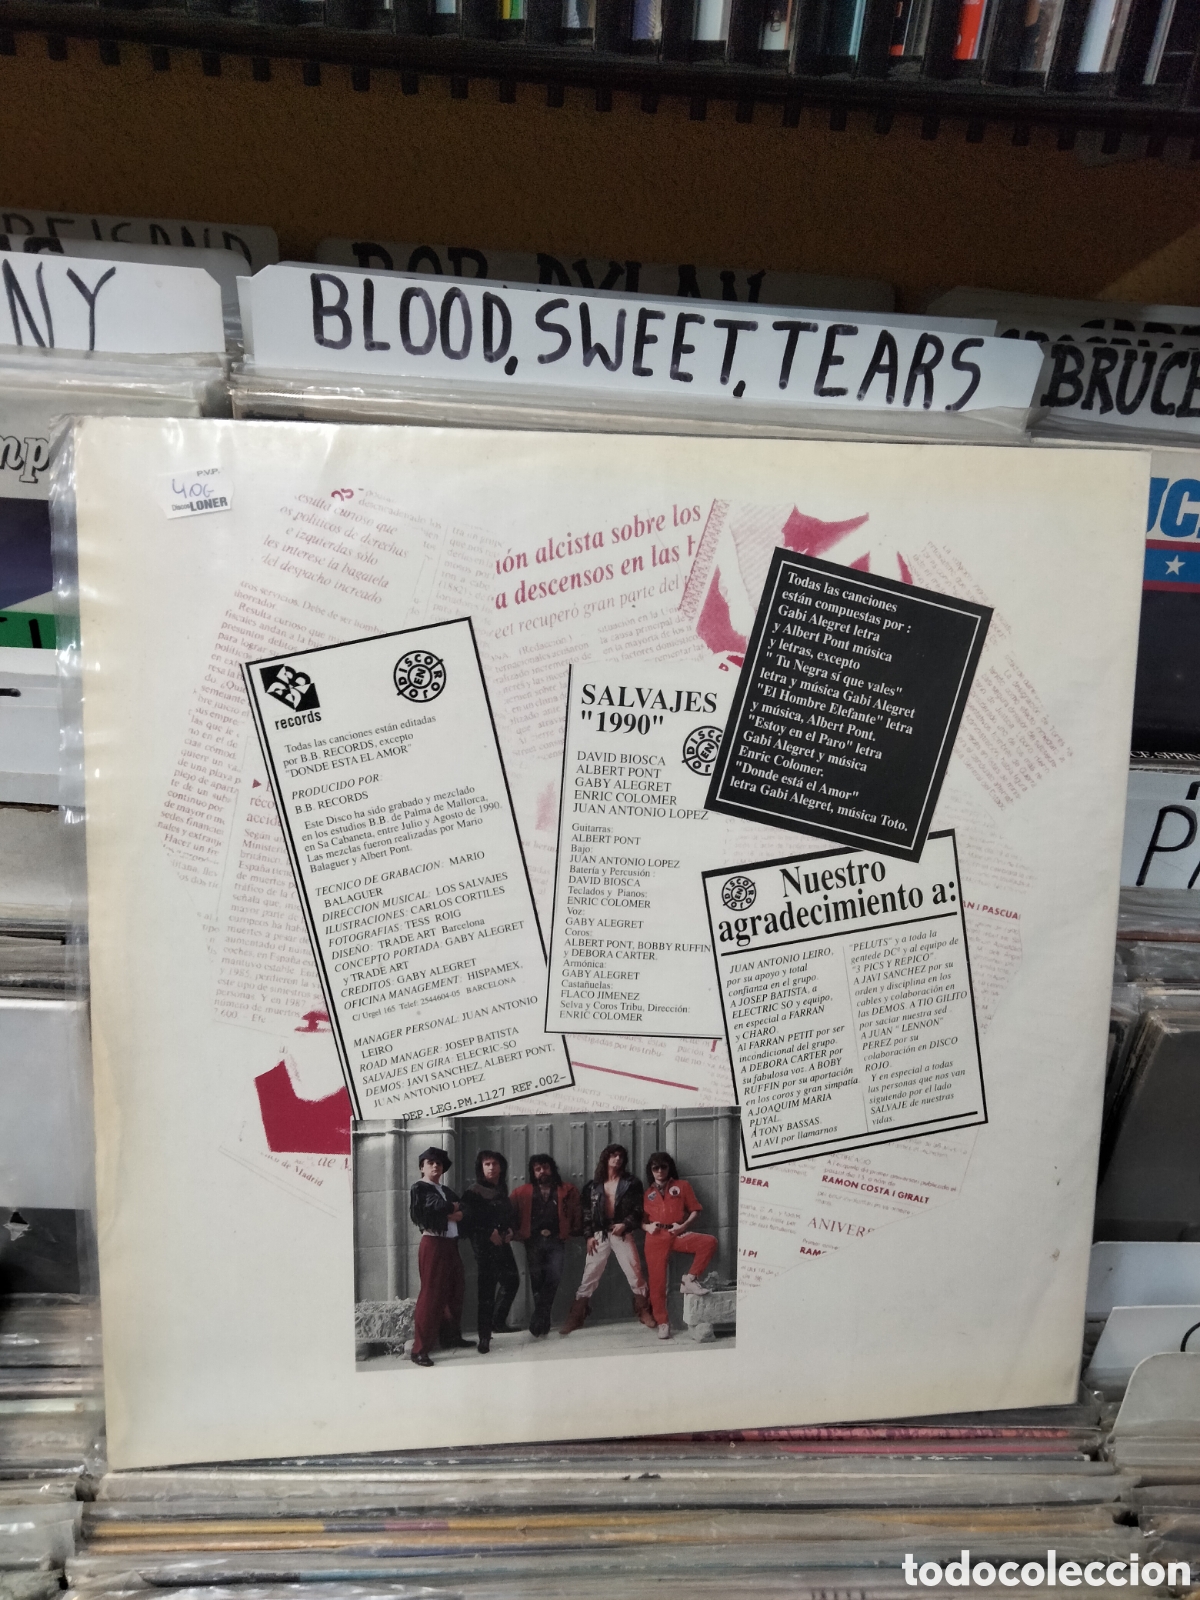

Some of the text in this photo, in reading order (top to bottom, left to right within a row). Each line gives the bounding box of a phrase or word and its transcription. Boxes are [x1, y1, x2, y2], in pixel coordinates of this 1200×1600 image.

[772, 319, 985, 412] TEARS
[535, 531, 604, 564] alcista
[611, 514, 665, 544] sobre
[672, 504, 701, 527] los
[279, 560, 332, 586] despacho
[514, 564, 614, 605] descensos
[620, 555, 644, 575] en
[651, 544, 680, 567] las
[788, 571, 898, 612] Todas las canciones
[583, 597, 615, 618] gran
[619, 585, 654, 608] parte
[658, 574, 679, 594] del
[781, 590, 905, 631] están compuestas por
[771, 622, 892, 662] y Albert Pont música
[778, 604, 880, 642] Gabi Alegret letra
[776, 654, 903, 696] Tu Negra sí que vales"
[581, 683, 717, 713] SALVAJES
[757, 682, 913, 735] "El Hombre Elefante" letra
[274, 711, 322, 730] records
[284, 715, 436, 753] Todas las canciones están editadas
[748, 714, 882, 760] "Estoy en el Paro" letra
[576, 764, 661, 779] ALBERT PONT
[577, 750, 666, 766] DAVID BIOSCA
[738, 744, 824, 777] Enric Colomer.
[292, 778, 356, 800] PRODUCIDO
[574, 776, 672, 792] GABY ALEGRET
[574, 789, 677, 805] ENRIC COLOMER
[735, 760, 859, 800] "Donde está el Amor"
[572, 802, 709, 820] JUAN ANTONIO LOPEZ
[729, 775, 908, 832] letra Gabi Alegret, música Toto.
[322, 901, 379, 922] DIRECCION
[435, 883, 456, 896] LOS
[458, 871, 508, 890] SALVAJES
[324, 887, 383, 908] BALAGUER
[779, 859, 886, 898] Nuestro
[404, 916, 430, 929] TESS
[434, 909, 461, 922] ROIG
[718, 881, 956, 947] agradecimiento a:
[729, 961, 755, 974] JUAN
[757, 953, 800, 968] ANTONIO
[353, 1028, 402, 1048] MANAGER
[462, 1007, 489, 1021] JUAN
[491, 995, 538, 1014] ANTONIO
[732, 1002, 778, 1019] ELECTRIC
[781, 999, 794, 1009] SO
[858, 1010, 869, 1018] las
[909, 1000, 916, 1008] A
[918, 996, 934, 1007] TIO
[935, 990, 968, 1003] GILITO
[821, 1174, 859, 1189] RAMON
[860, 1183, 889, 1196] COSTA
[897, 1191, 929, 1203] GIRALT
